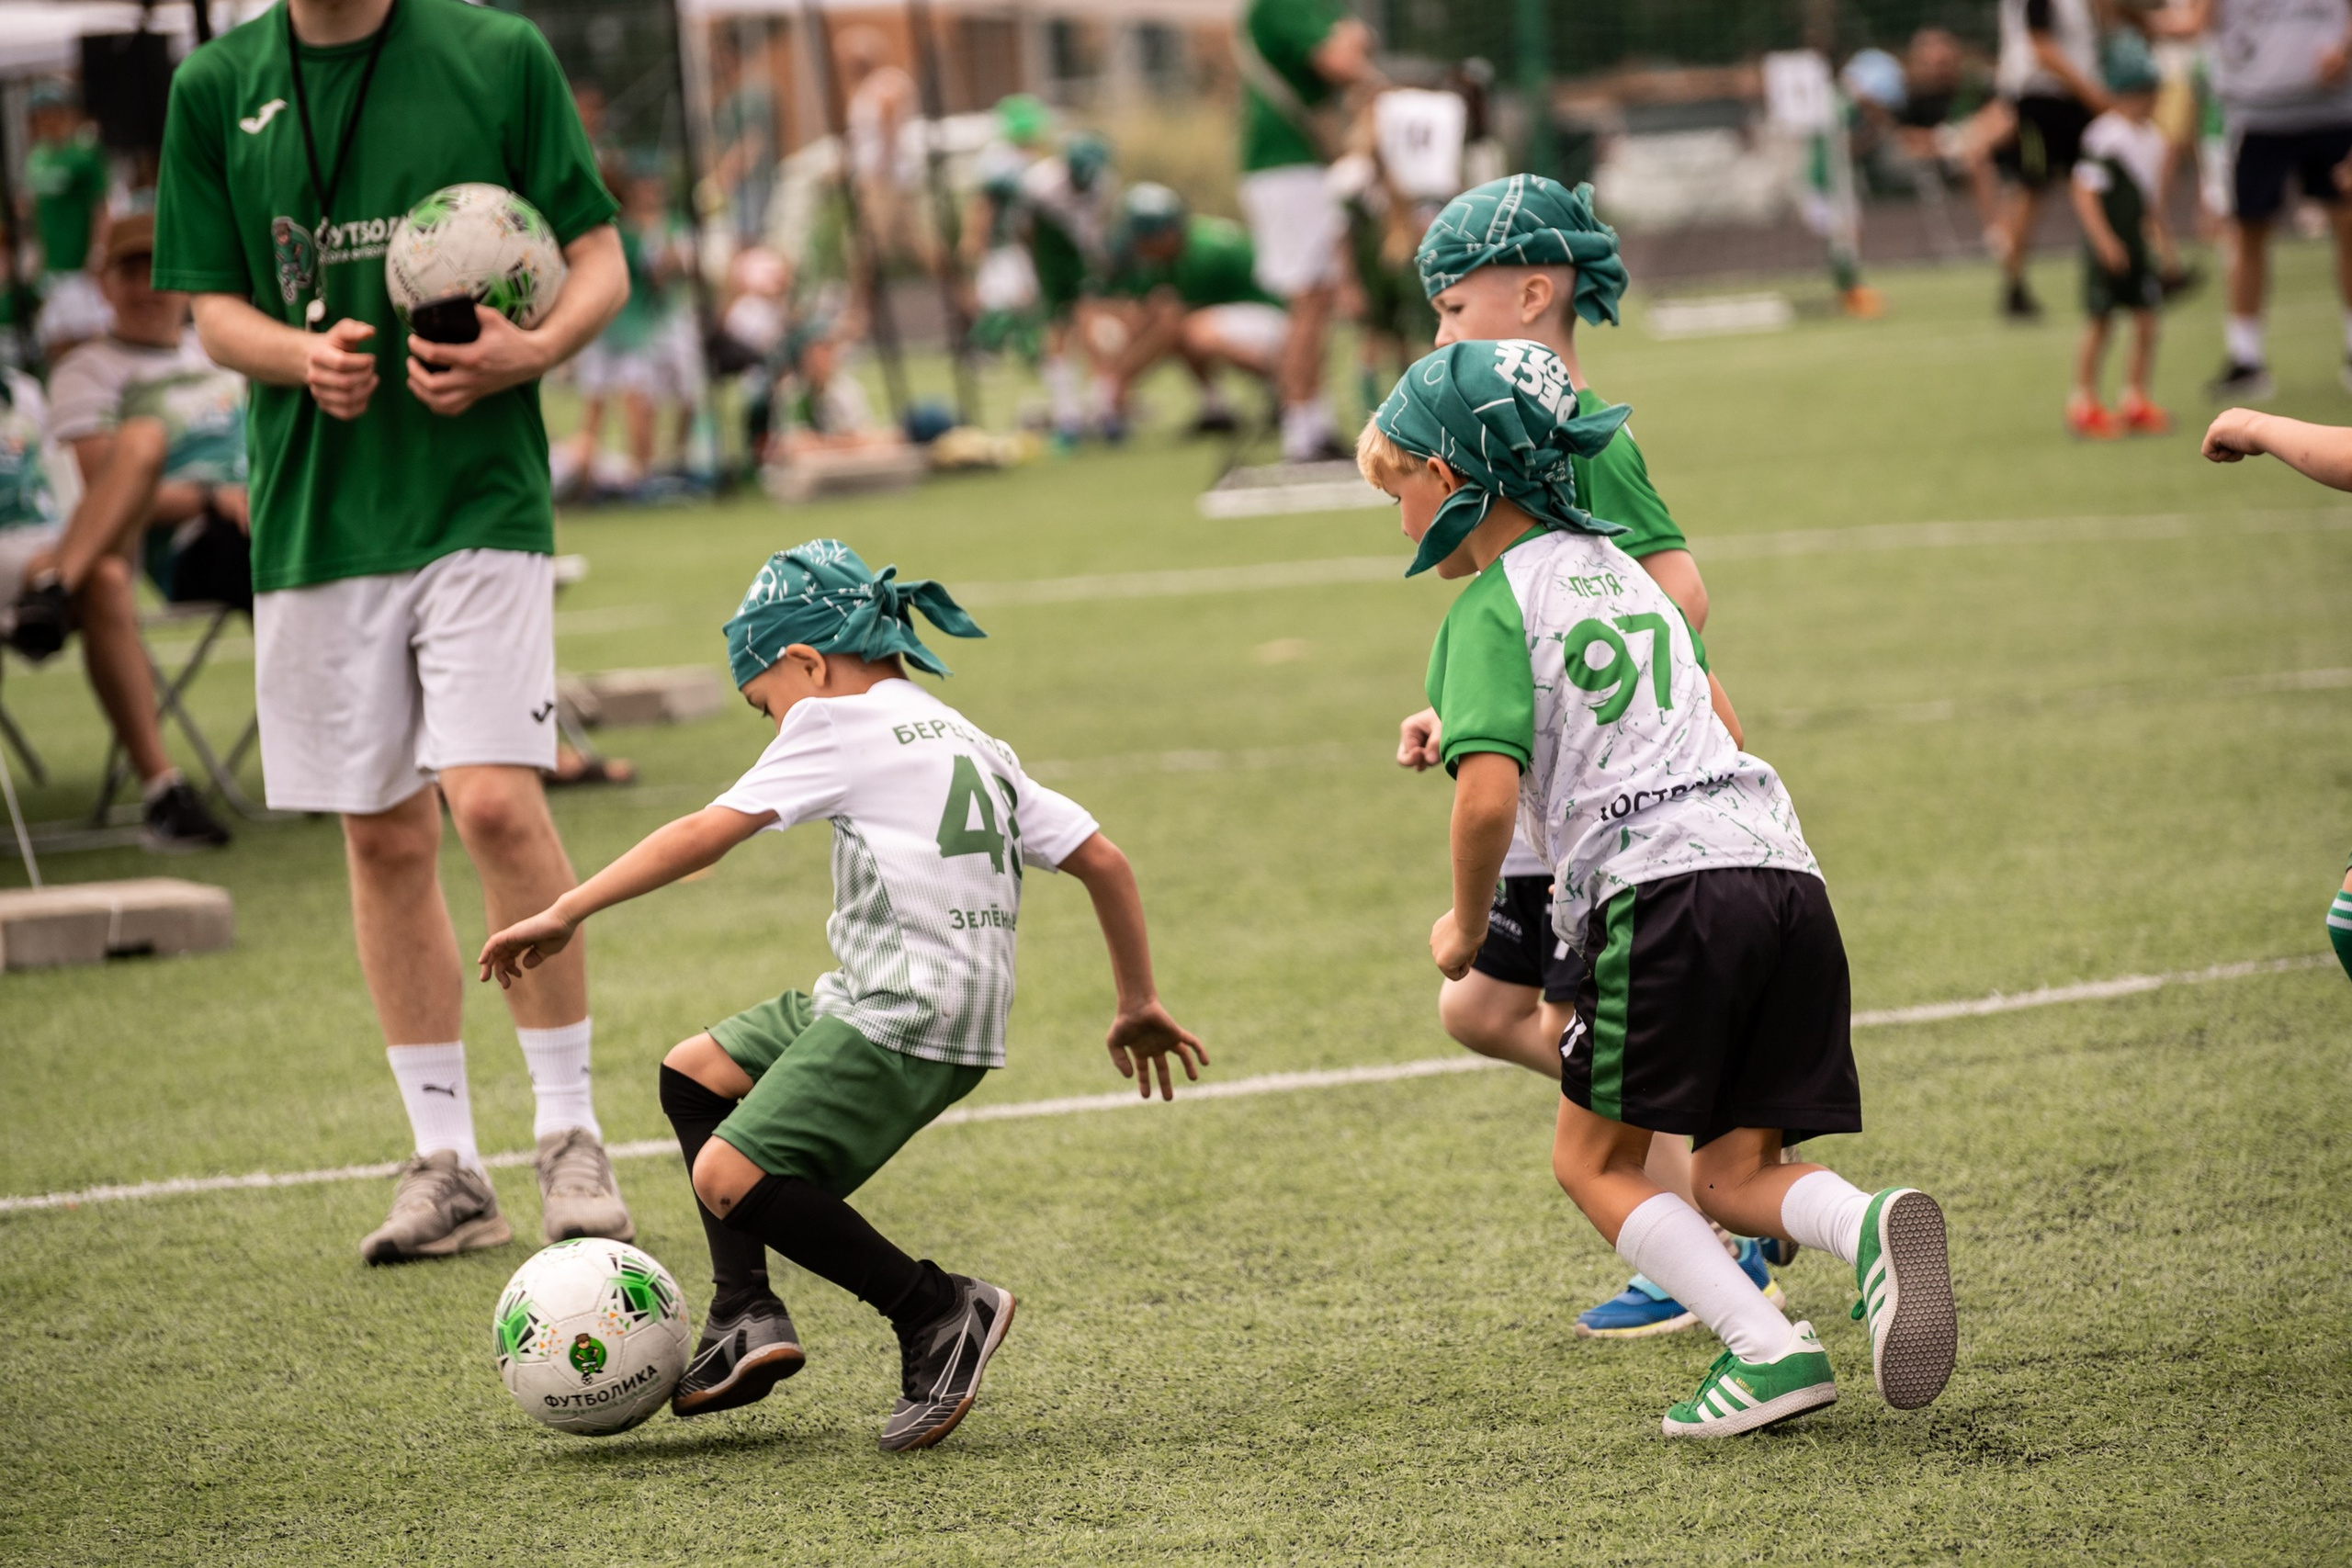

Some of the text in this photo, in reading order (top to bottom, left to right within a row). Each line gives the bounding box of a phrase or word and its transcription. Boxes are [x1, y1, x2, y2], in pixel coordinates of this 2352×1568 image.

[1568, 572, 1624, 598] ПЕТЯ
[1564, 612, 1674, 726] 97
[544, 1364, 658, 1408] ФУТБОЛИКА
